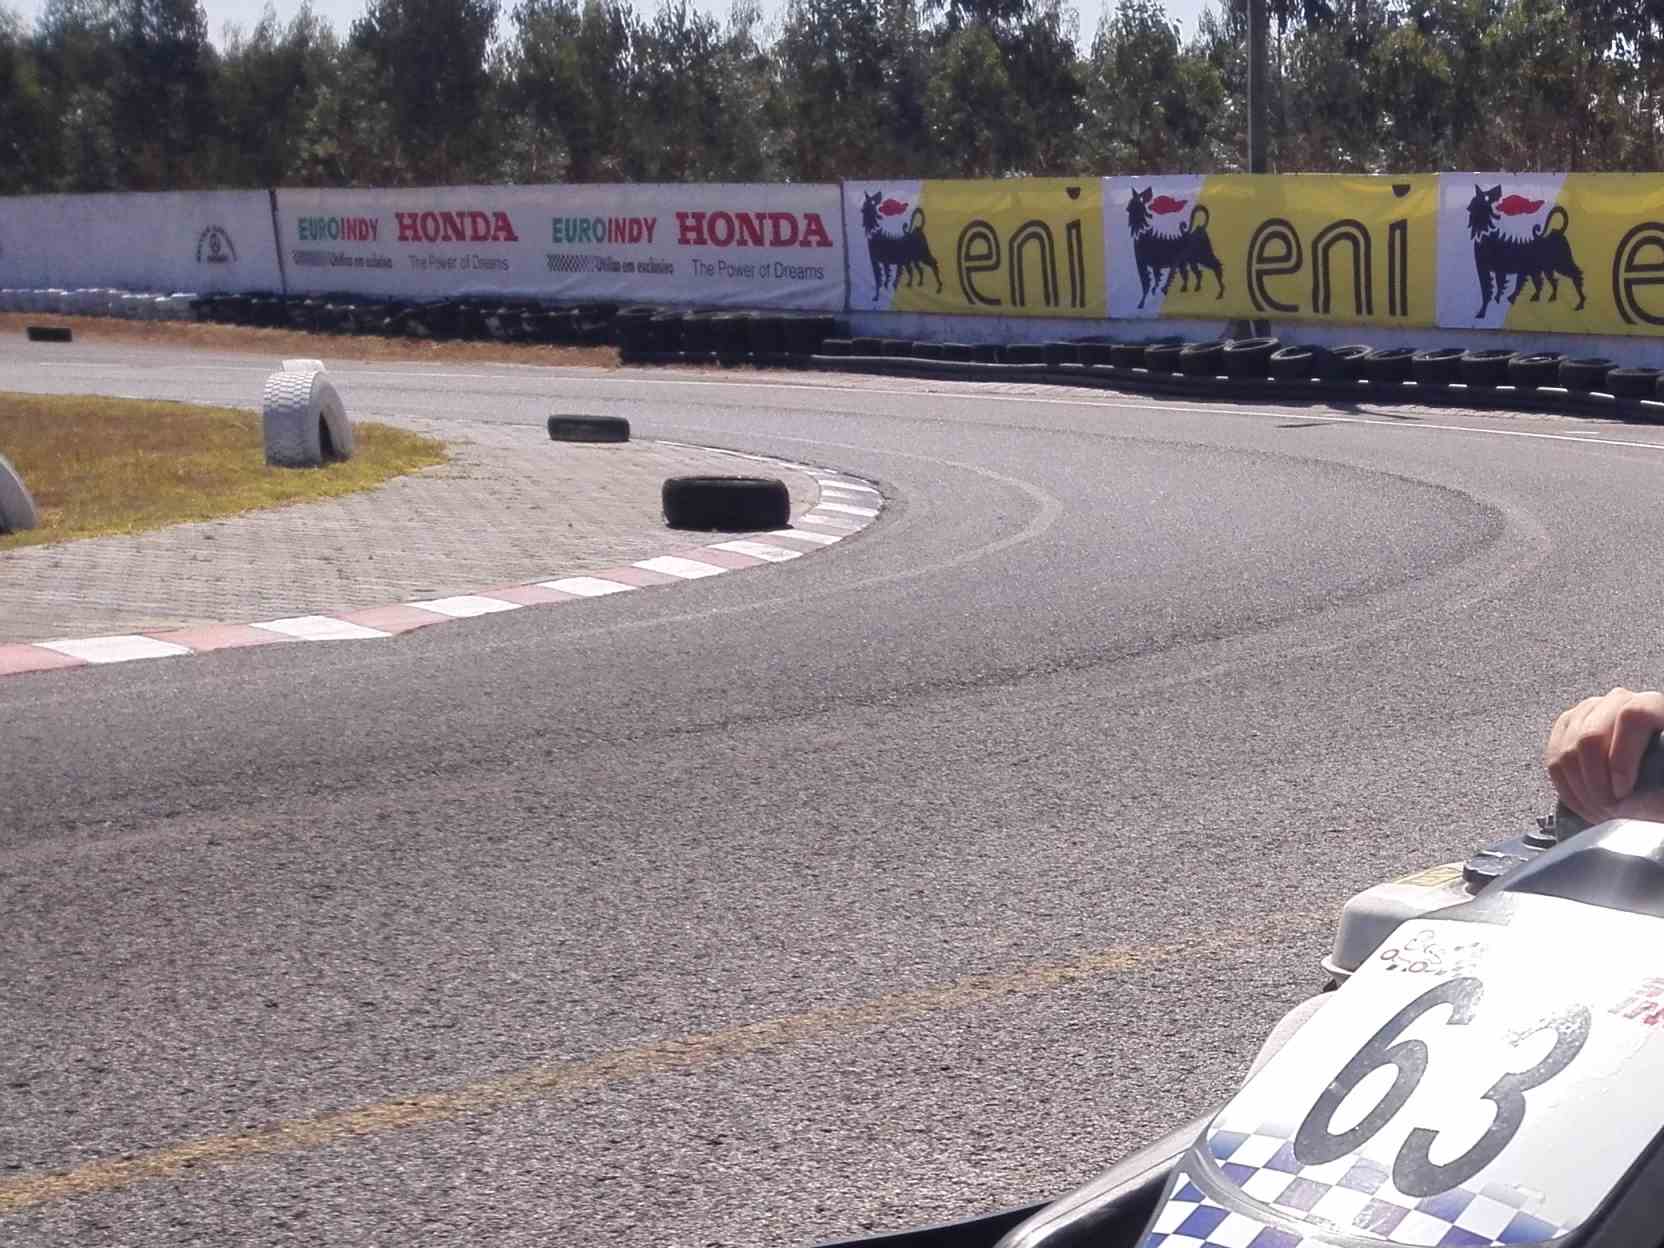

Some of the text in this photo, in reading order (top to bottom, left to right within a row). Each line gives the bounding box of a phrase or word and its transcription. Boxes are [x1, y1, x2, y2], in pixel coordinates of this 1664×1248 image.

[299, 217, 379, 241] EUROINDY
[395, 211, 518, 242] HONDA
[552, 217, 657, 243] EUROINDY
[675, 211, 833, 247] HONDA
[408, 254, 426, 269] The
[429, 254, 457, 270] Power
[472, 254, 509, 271] Dreams
[957, 187, 1087, 309] eni
[1247, 184, 1409, 316] eni
[692, 259, 824, 280] The Power of Dreams
[1293, 976, 1592, 1198] 63
